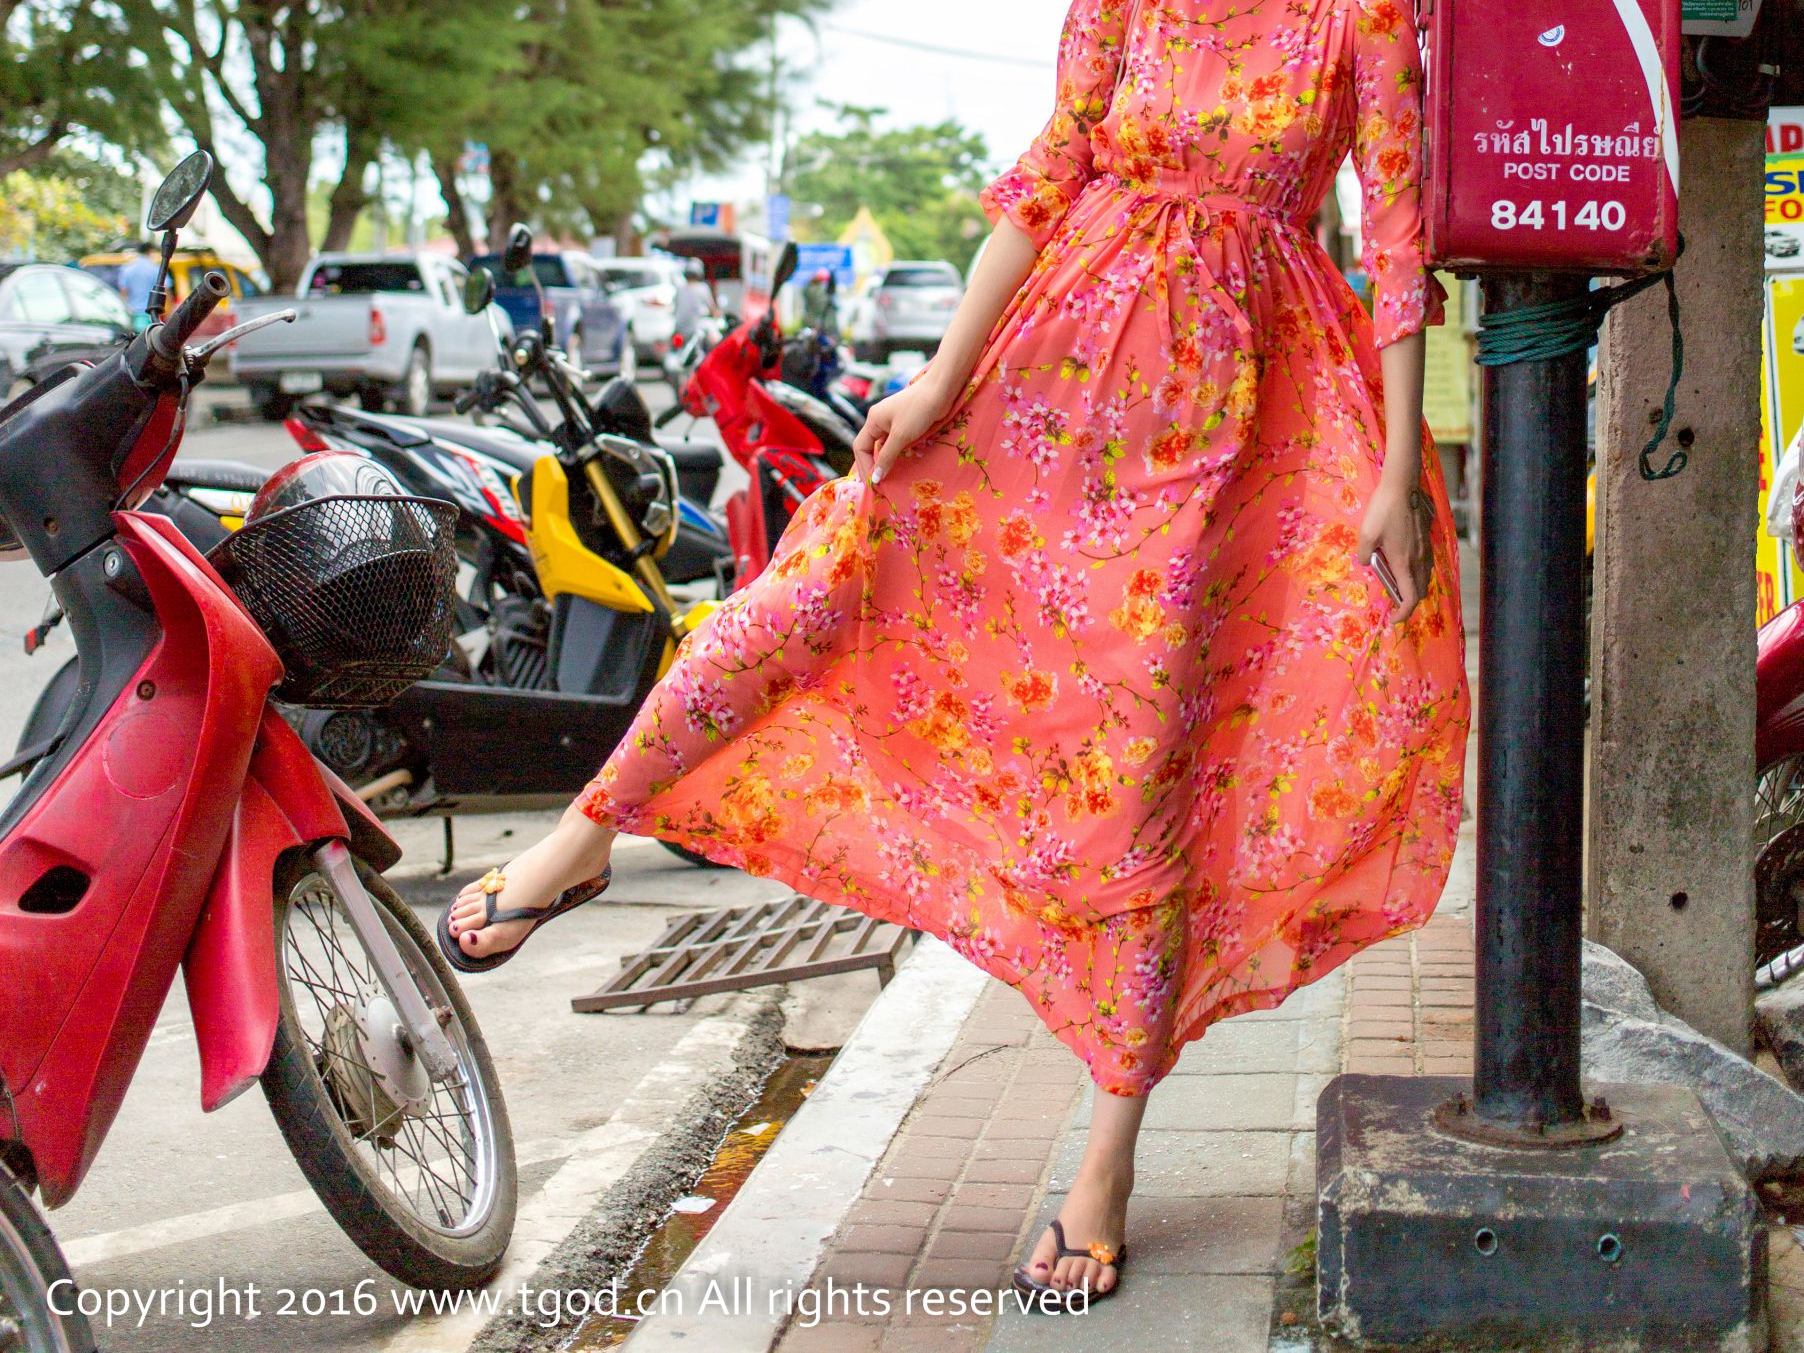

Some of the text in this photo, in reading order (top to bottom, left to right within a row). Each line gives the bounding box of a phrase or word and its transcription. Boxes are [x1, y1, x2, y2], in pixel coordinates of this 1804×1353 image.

[1504, 162, 1631, 182] POST CODE
[1490, 199, 1626, 231] 84140
